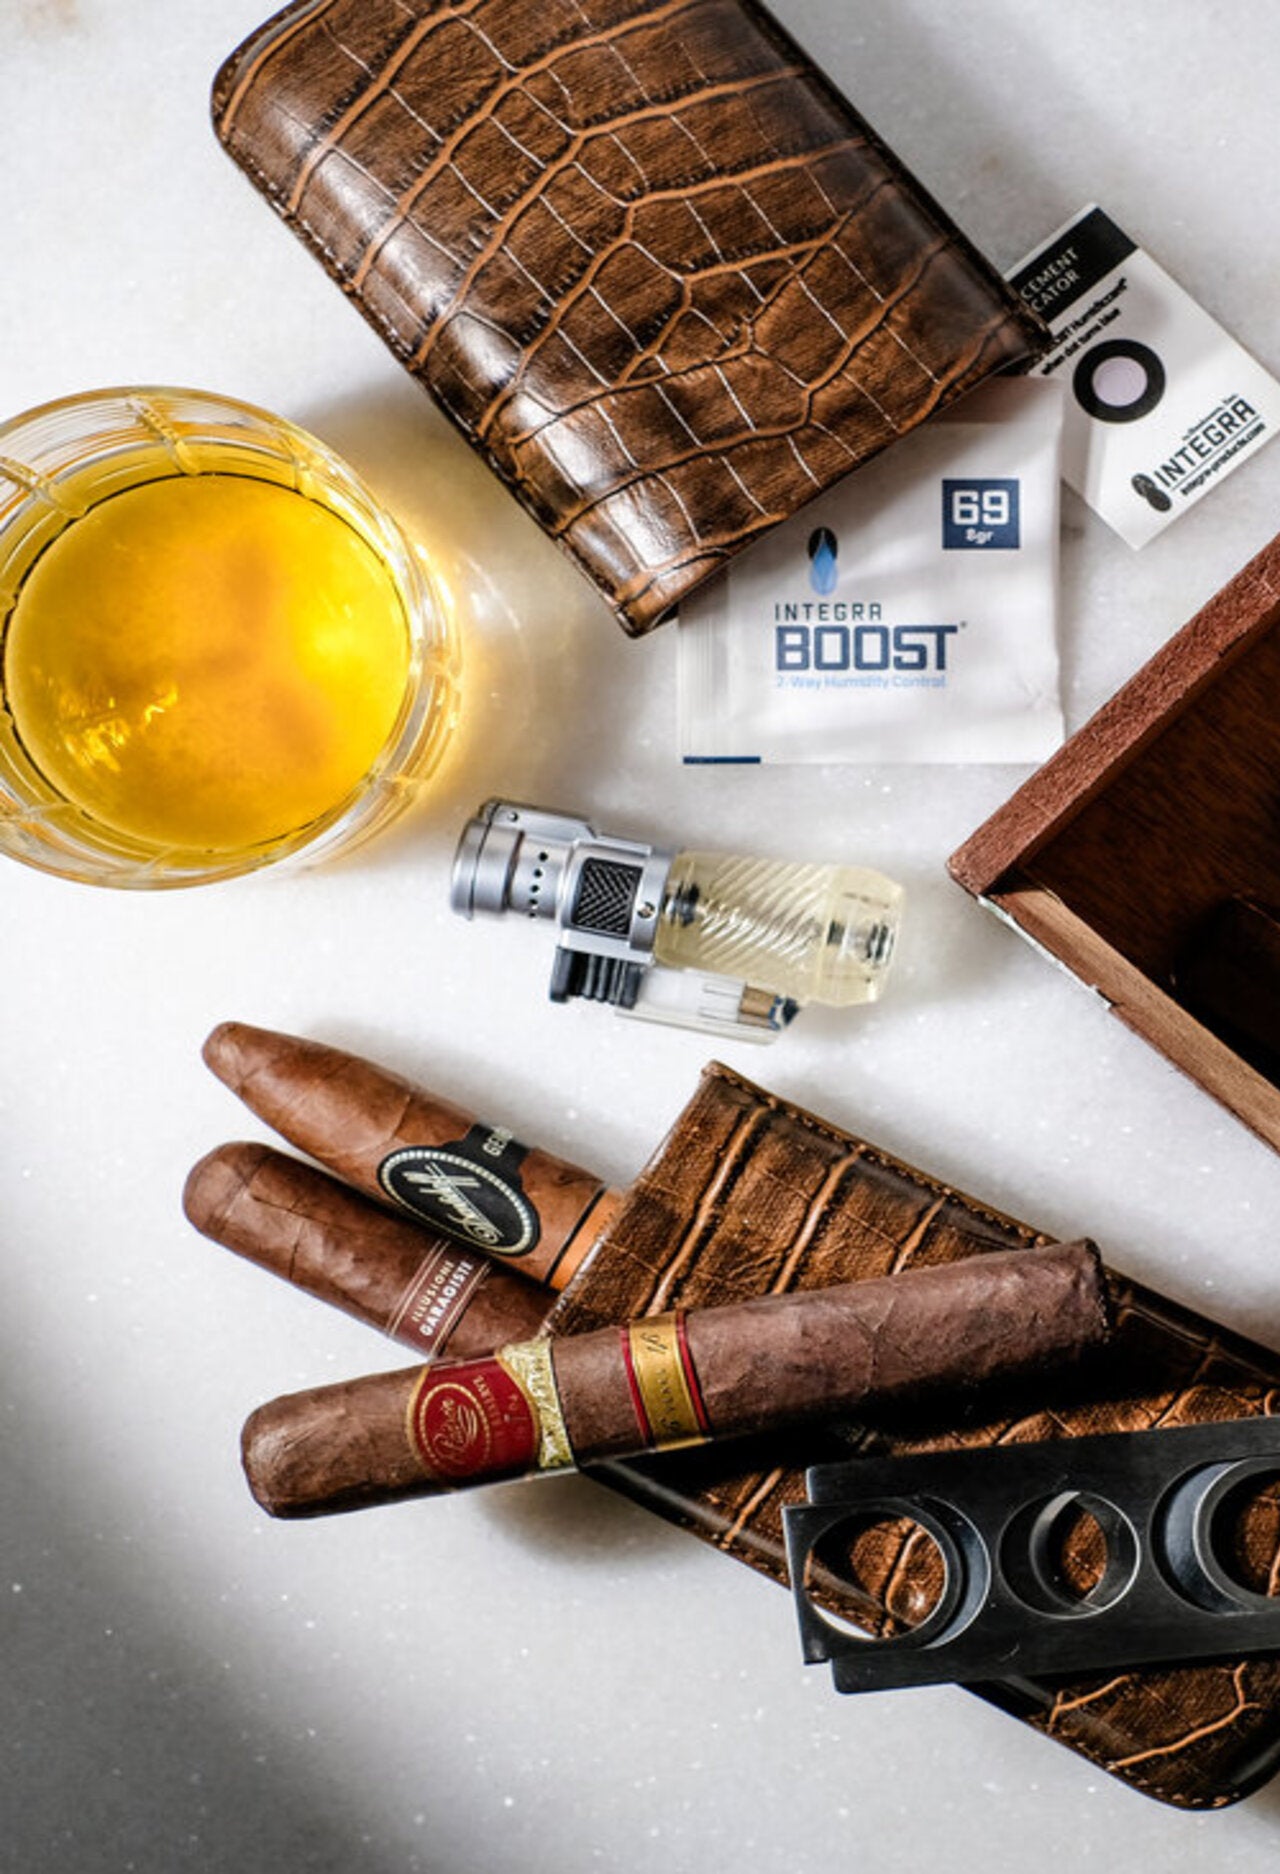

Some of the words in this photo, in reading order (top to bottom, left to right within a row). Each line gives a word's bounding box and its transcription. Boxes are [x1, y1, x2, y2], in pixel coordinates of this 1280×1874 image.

[1020, 246, 1079, 299] CEMENT
[1031, 269, 1080, 312] CATOR
[1098, 307, 1121, 326] blue
[1154, 397, 1257, 487] INTEGRA
[951, 490, 1010, 526] 69
[774, 602, 882, 622] INTEGRA
[776, 624, 959, 672] BOOST
[825, 675, 888, 689] Humidity
[893, 675, 945, 688] Control
